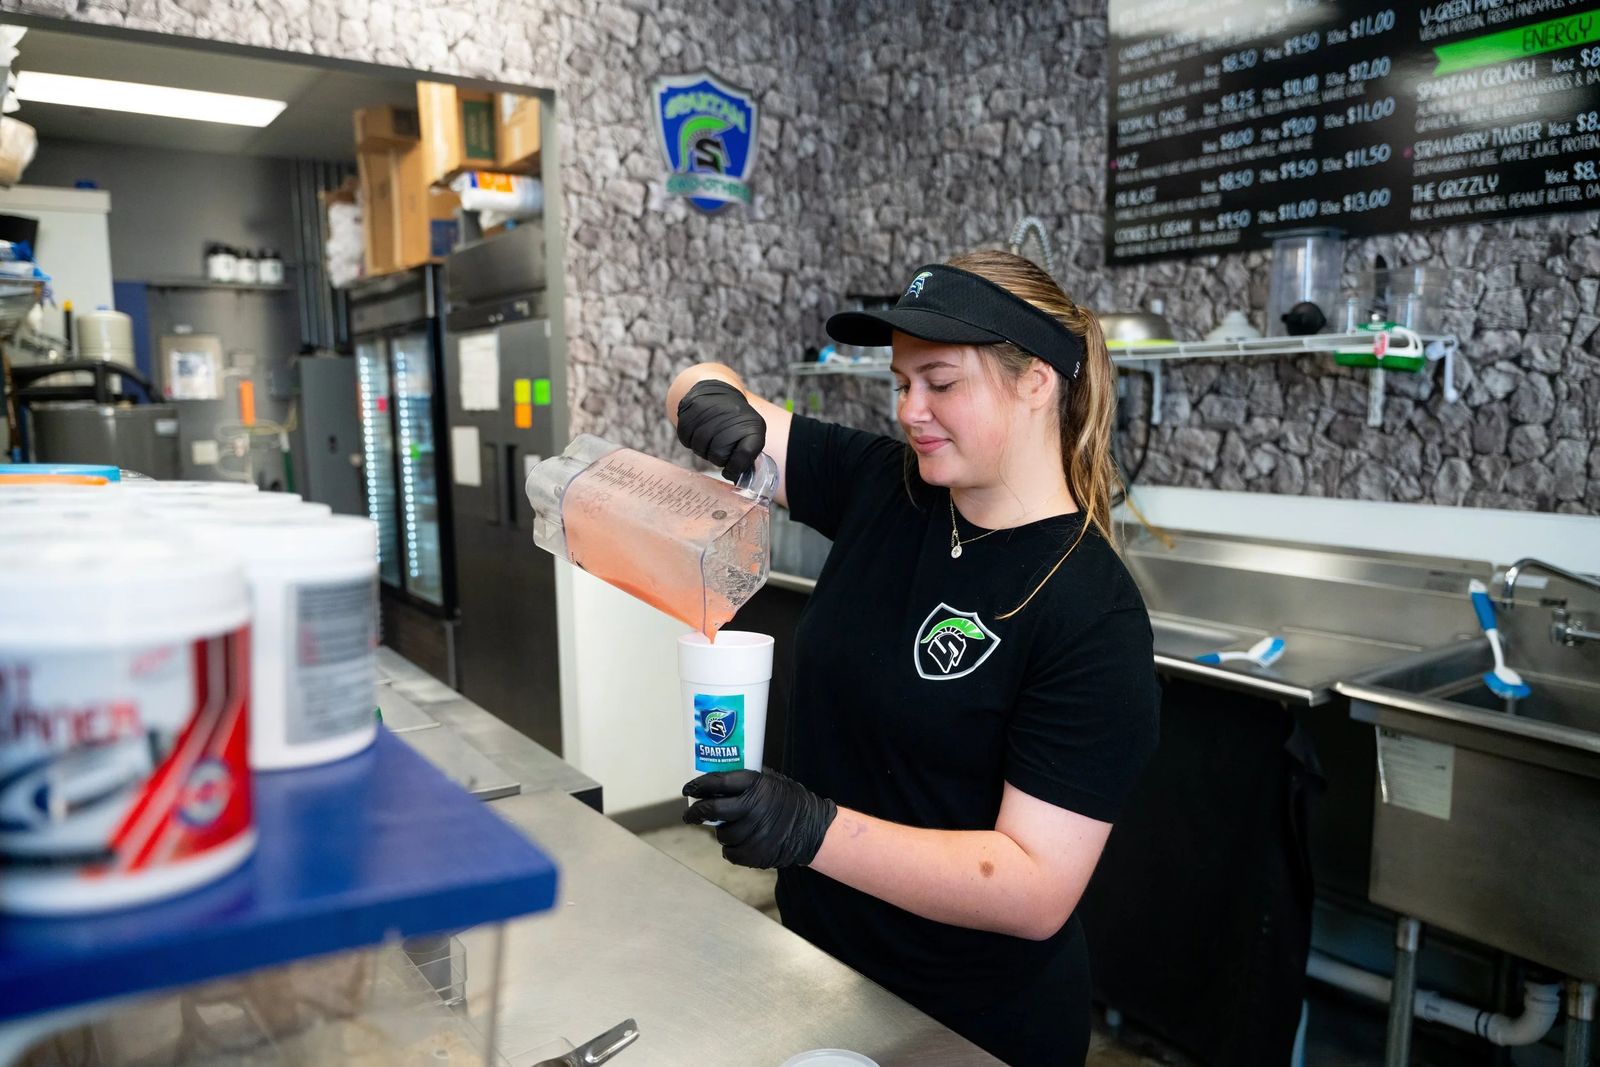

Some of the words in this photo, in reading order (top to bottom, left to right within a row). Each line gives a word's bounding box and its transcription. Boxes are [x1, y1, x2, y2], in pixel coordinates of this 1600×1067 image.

[1221, 48, 1258, 73] $8.50
[1284, 31, 1320, 57] $9.50
[1350, 9, 1396, 39] $11.00
[1523, 15, 1593, 52] ENERGY
[1282, 73, 1319, 97] $10.00
[1348, 55, 1391, 81] $12.00
[1417, 73, 1478, 100] SPARTAN
[1481, 60, 1536, 87] CRUNCH
[1575, 72, 1584, 87] &
[1346, 96, 1396, 124] $11.00
[1414, 131, 1488, 161] STRAWBERRY
[1492, 121, 1542, 147] TWISTER
[1219, 168, 1255, 191] $8.50
[1280, 158, 1319, 180] $9.50
[1345, 143, 1392, 169] $11.50
[1412, 182, 1435, 203] THE
[1438, 173, 1500, 200] GRIZZLY
[1508, 188, 1544, 208] PEANUT
[1160, 219, 1193, 238] CREAM
[1217, 208, 1252, 230] $9.50
[1278, 198, 1318, 221] $11.00
[1343, 187, 1392, 212] $13.00
[699, 744, 739, 757] SPARTAN
